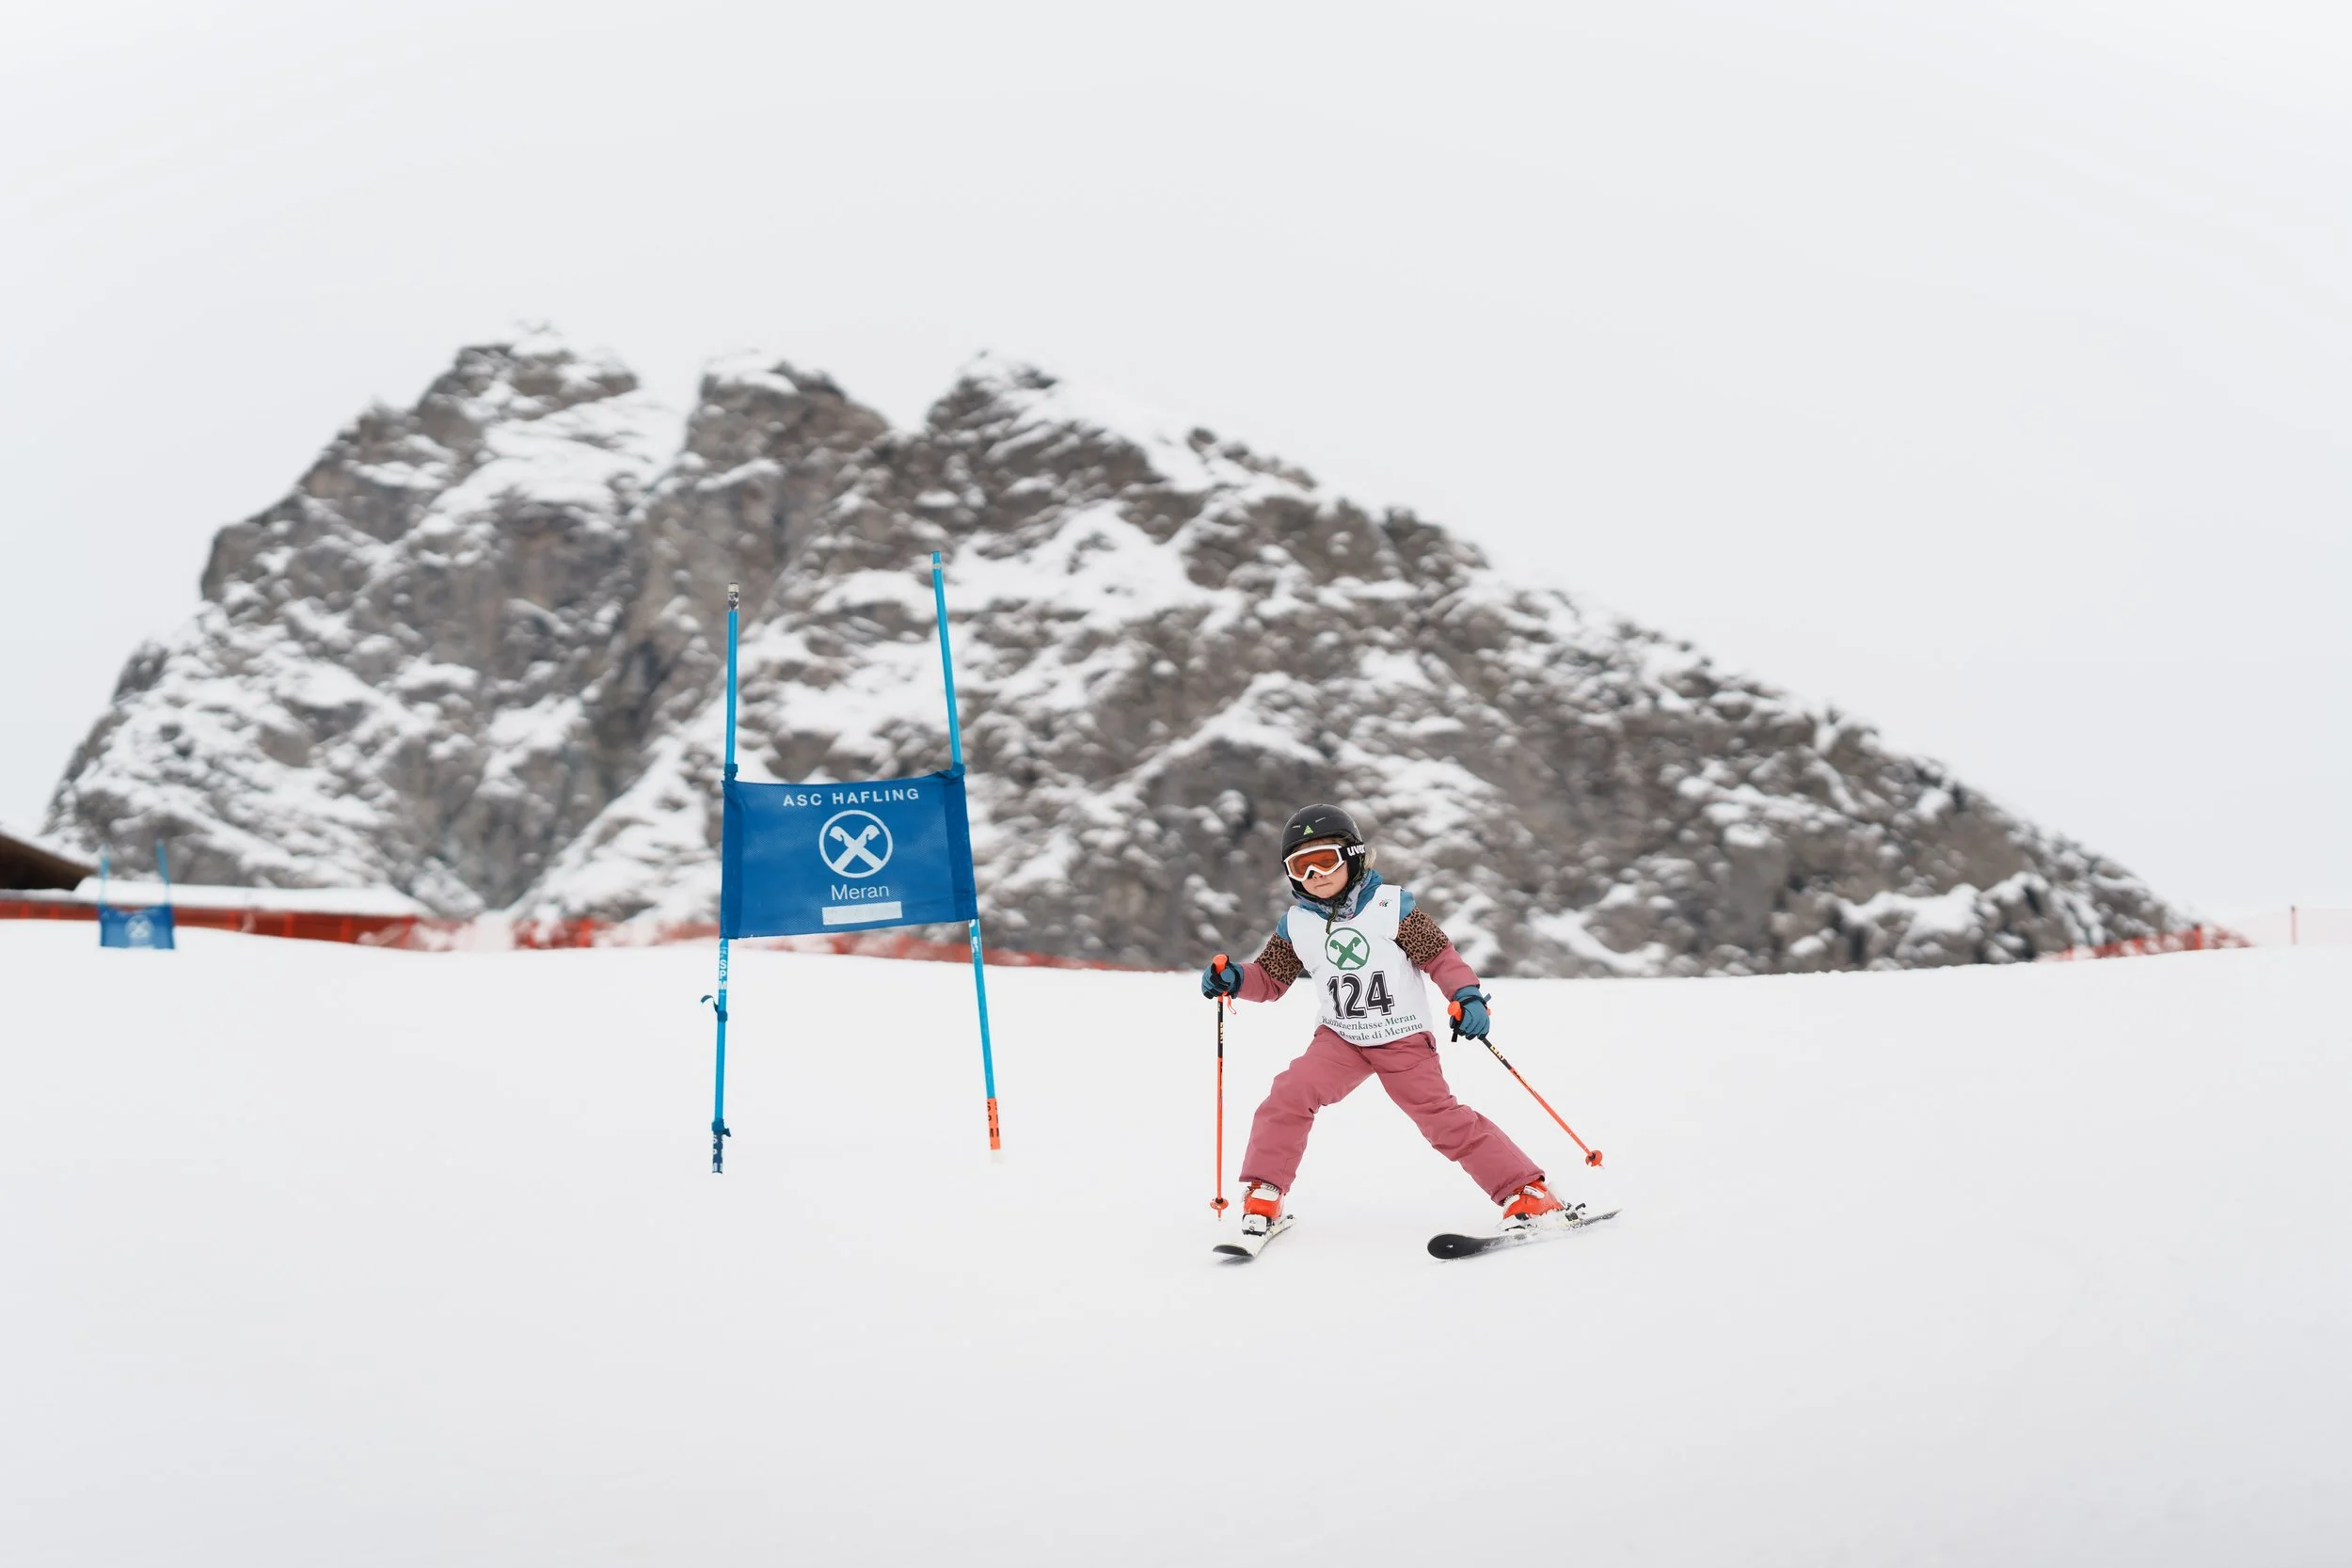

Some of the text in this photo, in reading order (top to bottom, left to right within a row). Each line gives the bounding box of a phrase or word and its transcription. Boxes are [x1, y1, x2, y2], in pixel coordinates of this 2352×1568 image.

[783, 788, 919, 807] ASC HAFLING
[831, 884, 889, 900] Meran
[1327, 971, 1395, 1020] 124
[1385, 1014, 1417, 1027] Meran
[1372, 1031, 1383, 1040] di
[1385, 1022, 1422, 1037] Merano
